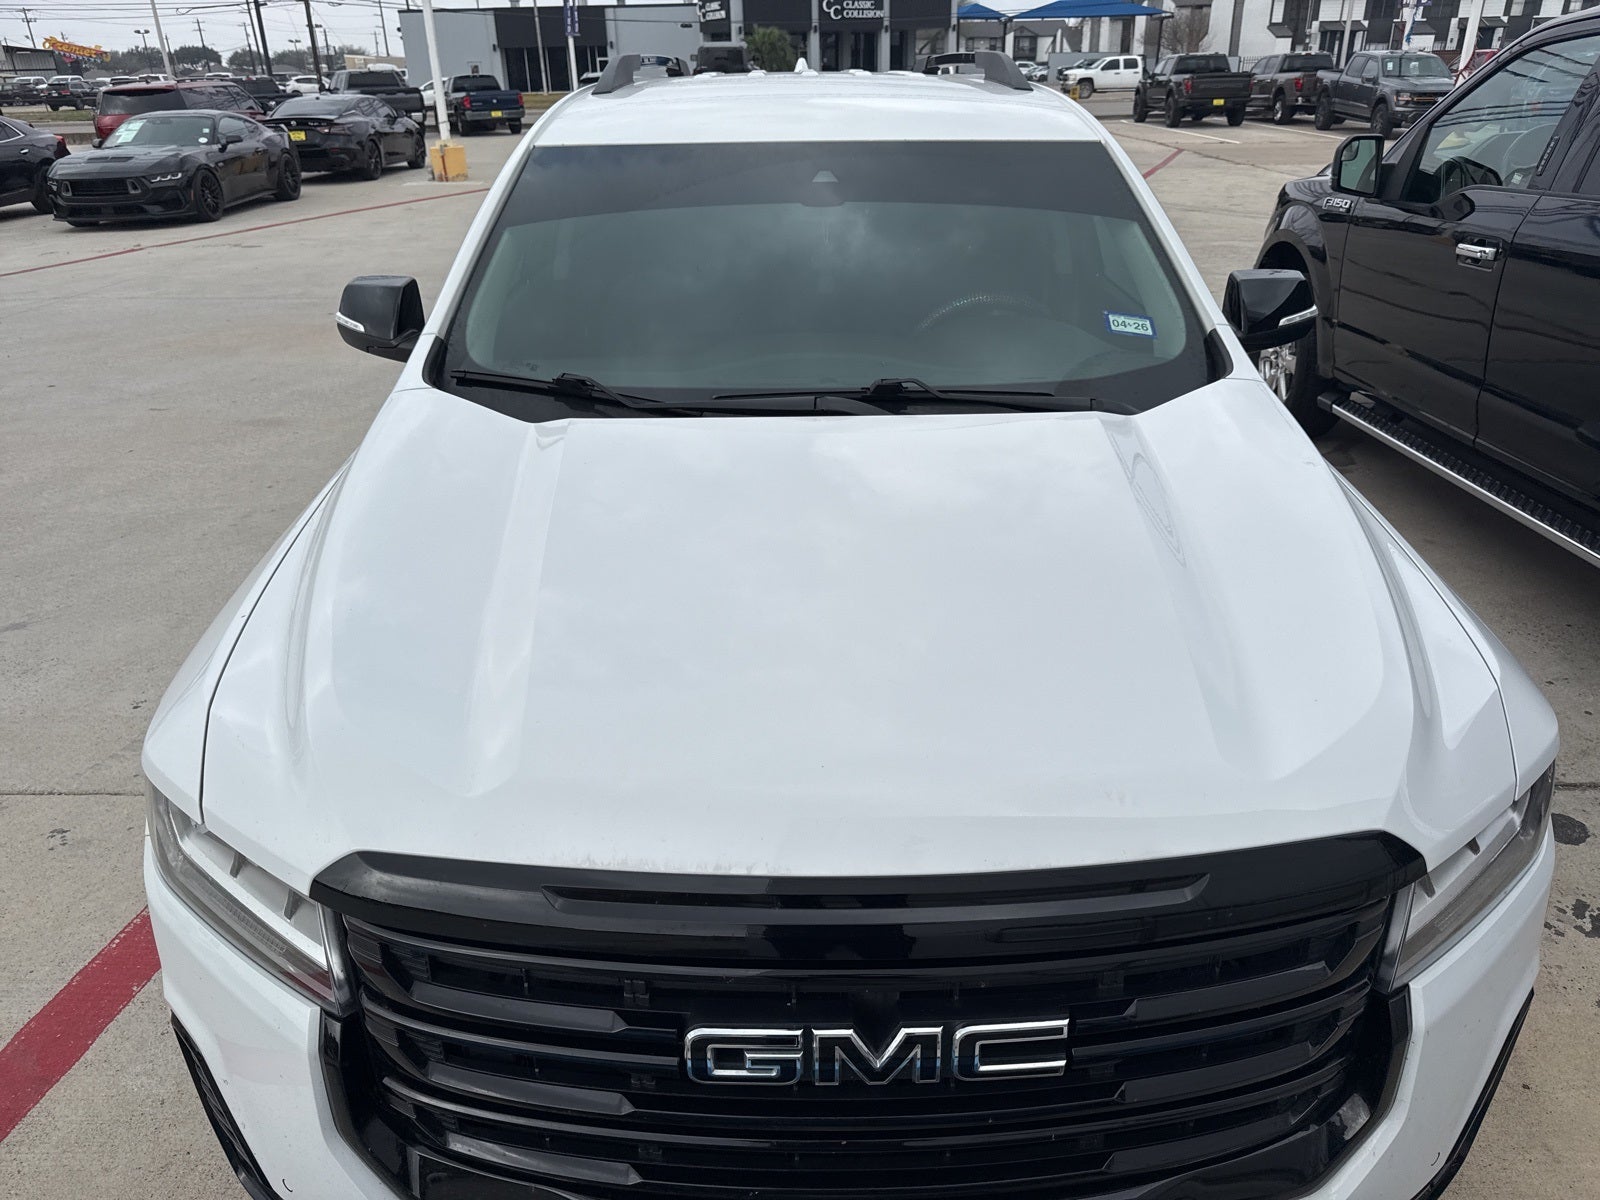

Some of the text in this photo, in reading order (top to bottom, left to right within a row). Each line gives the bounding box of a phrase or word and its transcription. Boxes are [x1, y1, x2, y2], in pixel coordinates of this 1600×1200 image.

[843, 0, 875, 9] CLASSIC
[843, 9, 885, 18] COLLISION
[684, 1018, 1070, 1086] GMC
